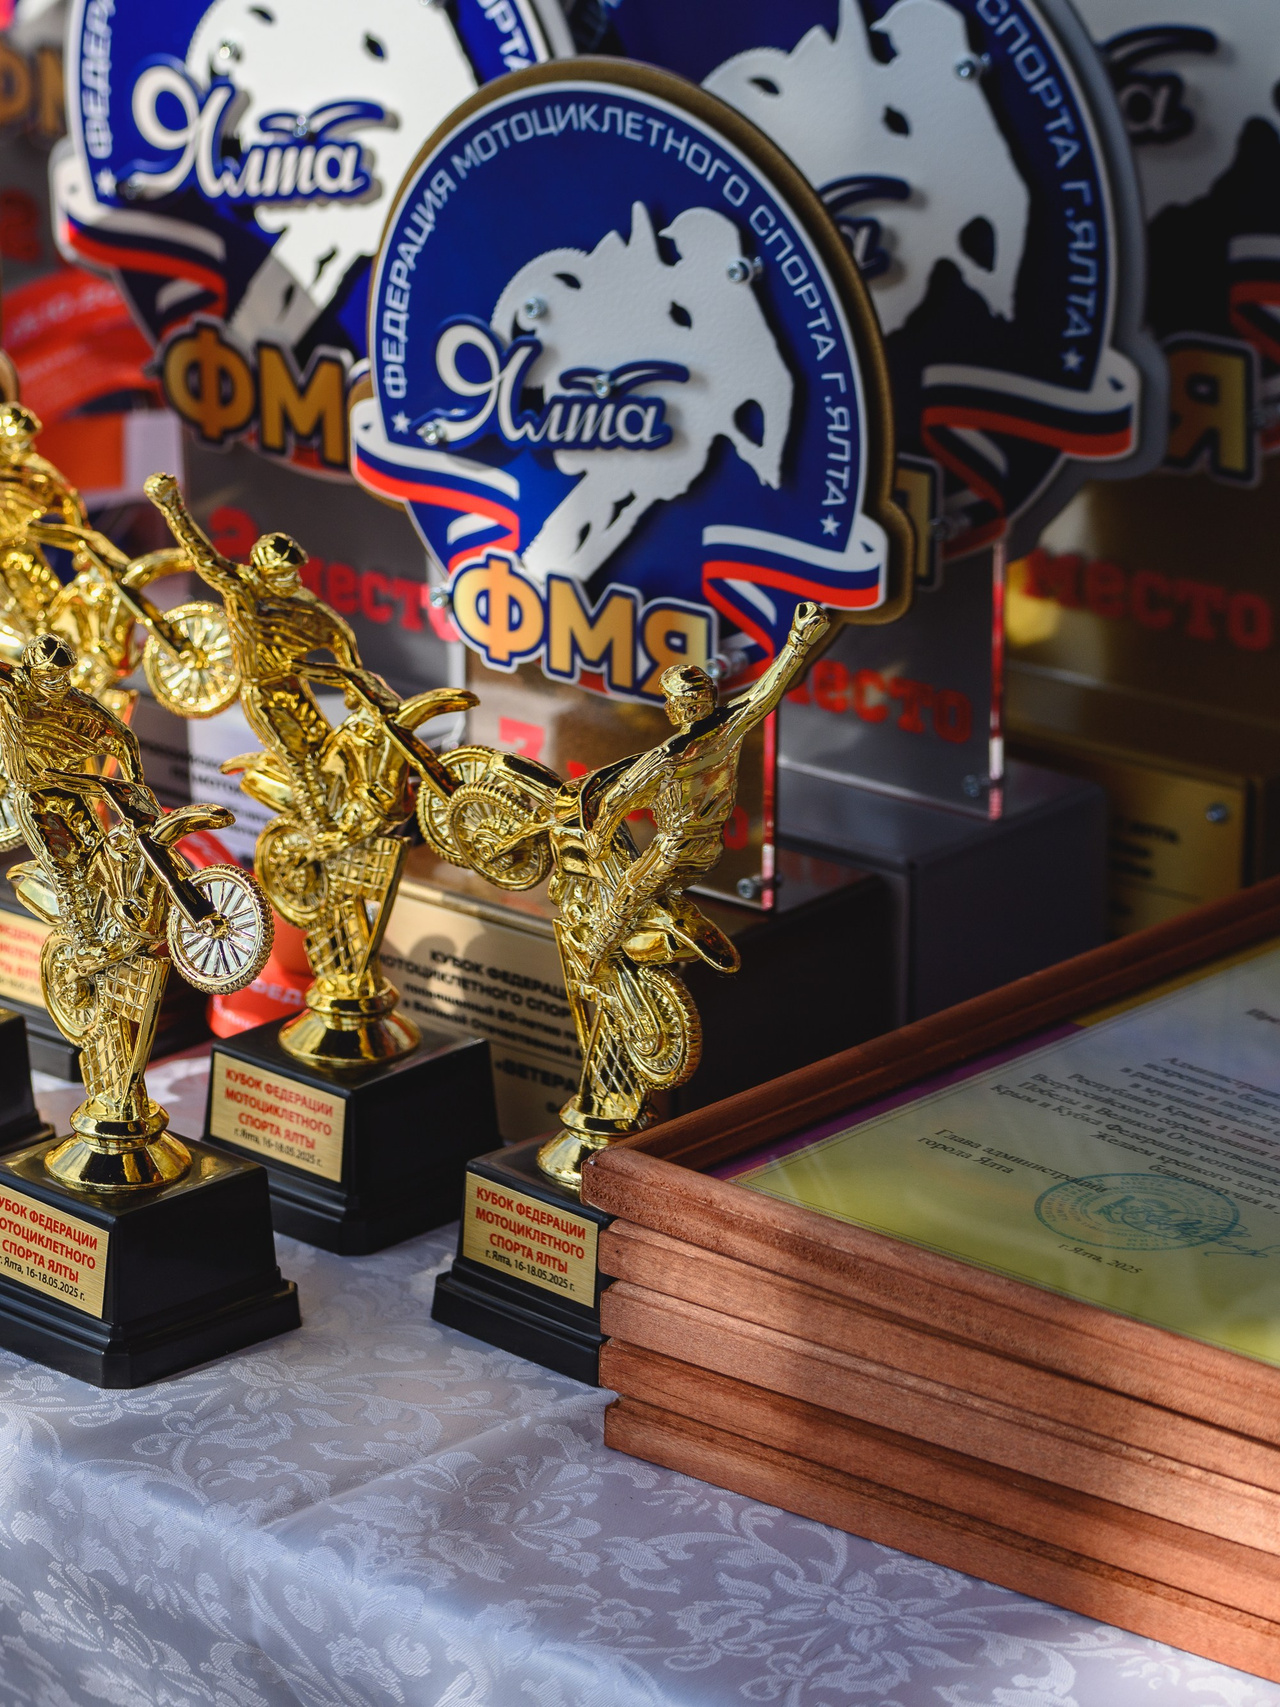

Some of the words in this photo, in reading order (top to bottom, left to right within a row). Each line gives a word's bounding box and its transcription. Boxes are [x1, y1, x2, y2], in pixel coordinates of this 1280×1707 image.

[131, 65, 365, 198] Ялта
[381, 168, 458, 400] ФЕДЕРАЦИЯ
[450, 102, 751, 208] МОТОЦИКЛЕТНОГО
[749, 204, 838, 361] СПОРТА
[821, 372, 852, 507] Г.ЯЛТА
[435, 324, 667, 443] Ялта
[454, 560, 712, 694] ФМЯ
[430, 950, 484, 972] КУБОК
[487, 967, 569, 1001] ФЕДЕРАЦ
[526, 996, 572, 1020] СПОР
[225, 1068, 262, 1091] КУБОК
[264, 1082, 333, 1118] ФЕДЕРАЦИИ
[225, 1088, 332, 1136] МОТОЦИКЛЕТНОГО
[1017, 1081, 1081, 1105] Победы
[1094, 1107, 1166, 1135] Великой
[1030, 1073, 1156, 1119] Всероссийского
[1067, 1073, 1161, 1108] Республики
[238, 1112, 281, 1137] СПОРТА
[284, 1129, 315, 1150] ЯЛТЫ
[990, 1083, 1038, 1104] Крым
[1051, 1105, 1103, 1126] Кубка
[1105, 1123, 1195, 1158] Федерации
[918, 1136, 972, 1160] города
[973, 1156, 1015, 1175] Ялта
[934, 1128, 982, 1149] Глава
[982, 1146, 1110, 1194] администрации
[1089, 1130, 1156, 1157] Желаем
[1156, 1155, 1232, 1183] крепкого
[1148, 1164, 1264, 1206] благополучия
[29, 1209, 98, 1251] ФЕДЕРАЦИИ
[475, 1206, 585, 1260] МОТОЦИКЛЕТНОГО
[476, 1186, 513, 1212] КУБОК
[515, 1202, 586, 1240] ФЕДЕРАЦИИ
[2, 1239, 45, 1268] СПОРТА
[48, 1259, 79, 1284] ЯЛТЫ
[485, 1249, 491, 1259] г.
[492, 1250, 512, 1268] Ялта,
[514, 1259, 568, 1288] 16-18.05.2025
[569, 1282, 576, 1292] г.
[489, 1233, 534, 1261] СПОРТА
[536, 1252, 568, 1274] ЯЛТЫ
[1106, 1257, 1144, 1275] 2025
[4, 1257, 24, 1275] Ялта,
[26, 1266, 79, 1299] 16-18.05.2025
[79, 1290, 86, 1301] г.
